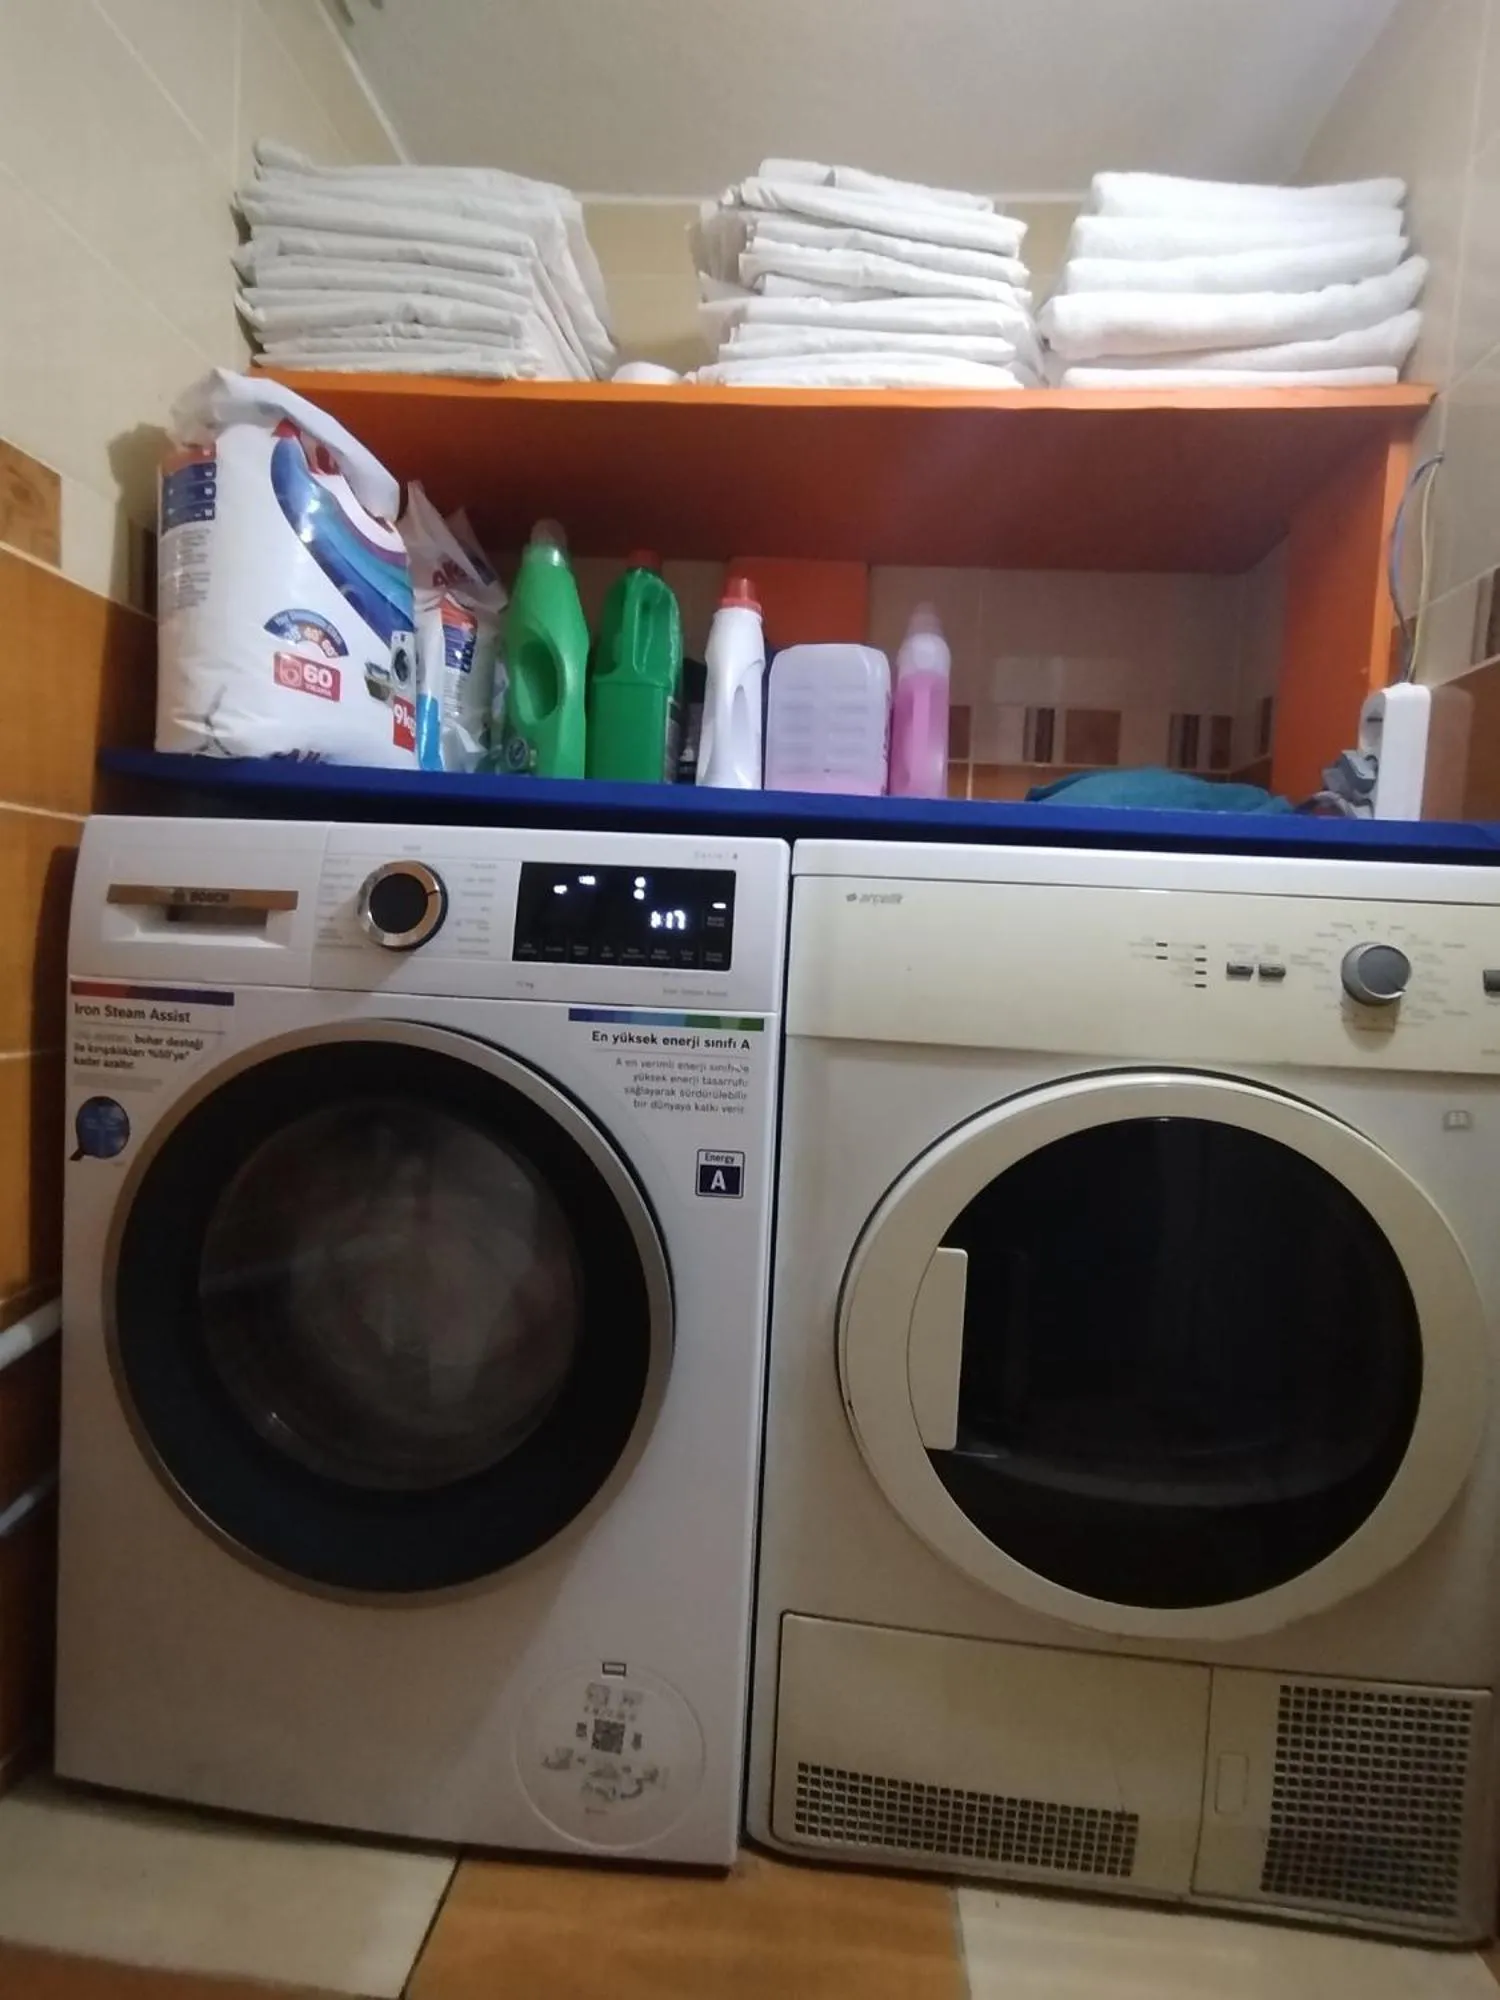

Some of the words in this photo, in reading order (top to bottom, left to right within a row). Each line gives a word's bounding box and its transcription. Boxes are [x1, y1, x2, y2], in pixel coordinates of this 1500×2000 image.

[303, 663, 333, 689] 60
[74, 1002, 101, 1017] Iron
[104, 1004, 147, 1020] Steam
[150, 1007, 191, 1023] Assist
[591, 1030, 609, 1042] En
[612, 1032, 658, 1045] yüksek
[662, 1034, 700, 1049] enerji
[704, 1036, 737, 1049] sınıfı
[740, 1039, 750, 1050] A
[615, 1057, 623, 1066] A
[677, 1061, 707, 1073] enerji
[633, 1072, 667, 1084] yüksek
[669, 1074, 700, 1086] enerji
[624, 1085, 676, 1098] sağlayarak
[704, 1152, 735, 1165] Energy
[710, 1168, 726, 1191] A
